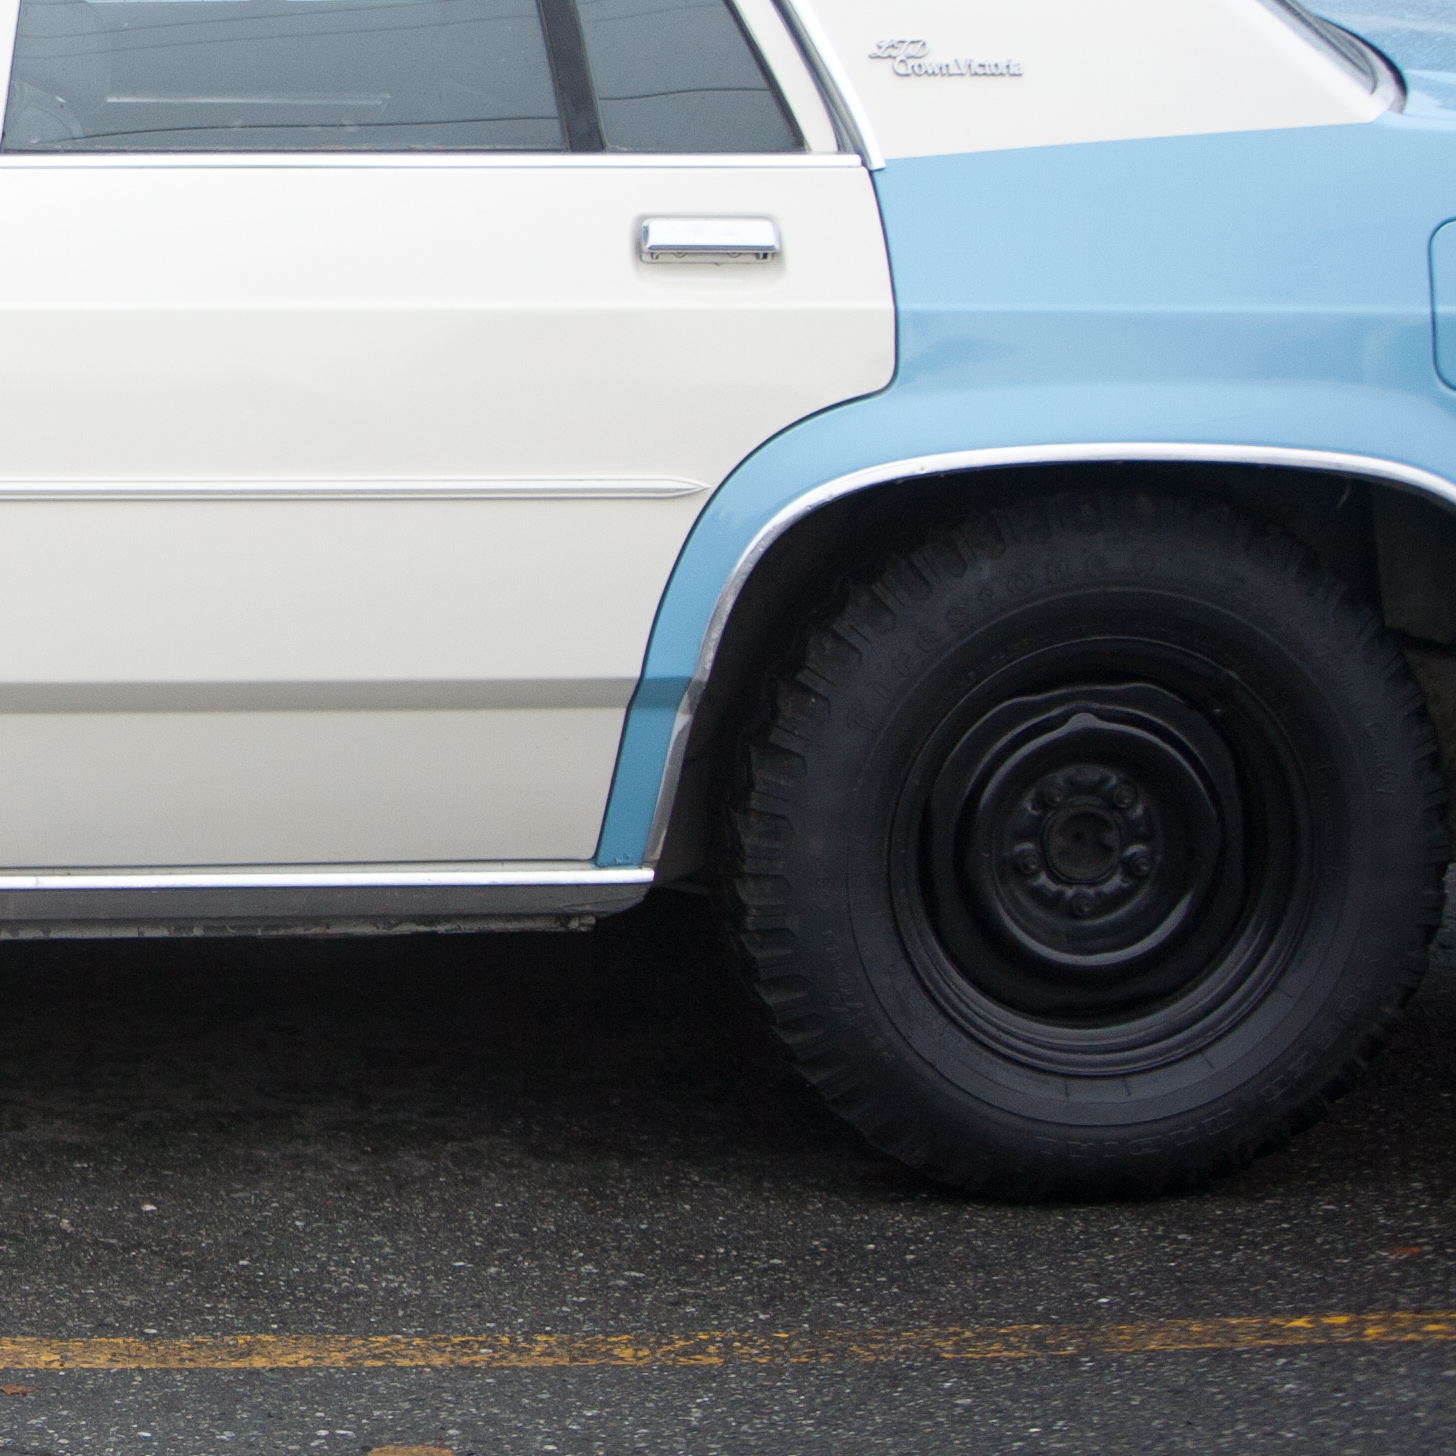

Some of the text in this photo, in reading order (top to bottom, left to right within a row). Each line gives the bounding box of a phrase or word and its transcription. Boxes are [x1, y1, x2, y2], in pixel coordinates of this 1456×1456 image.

[868, 39, 930, 59] LTD
[893, 56, 1023, 76] Crown Victoria
